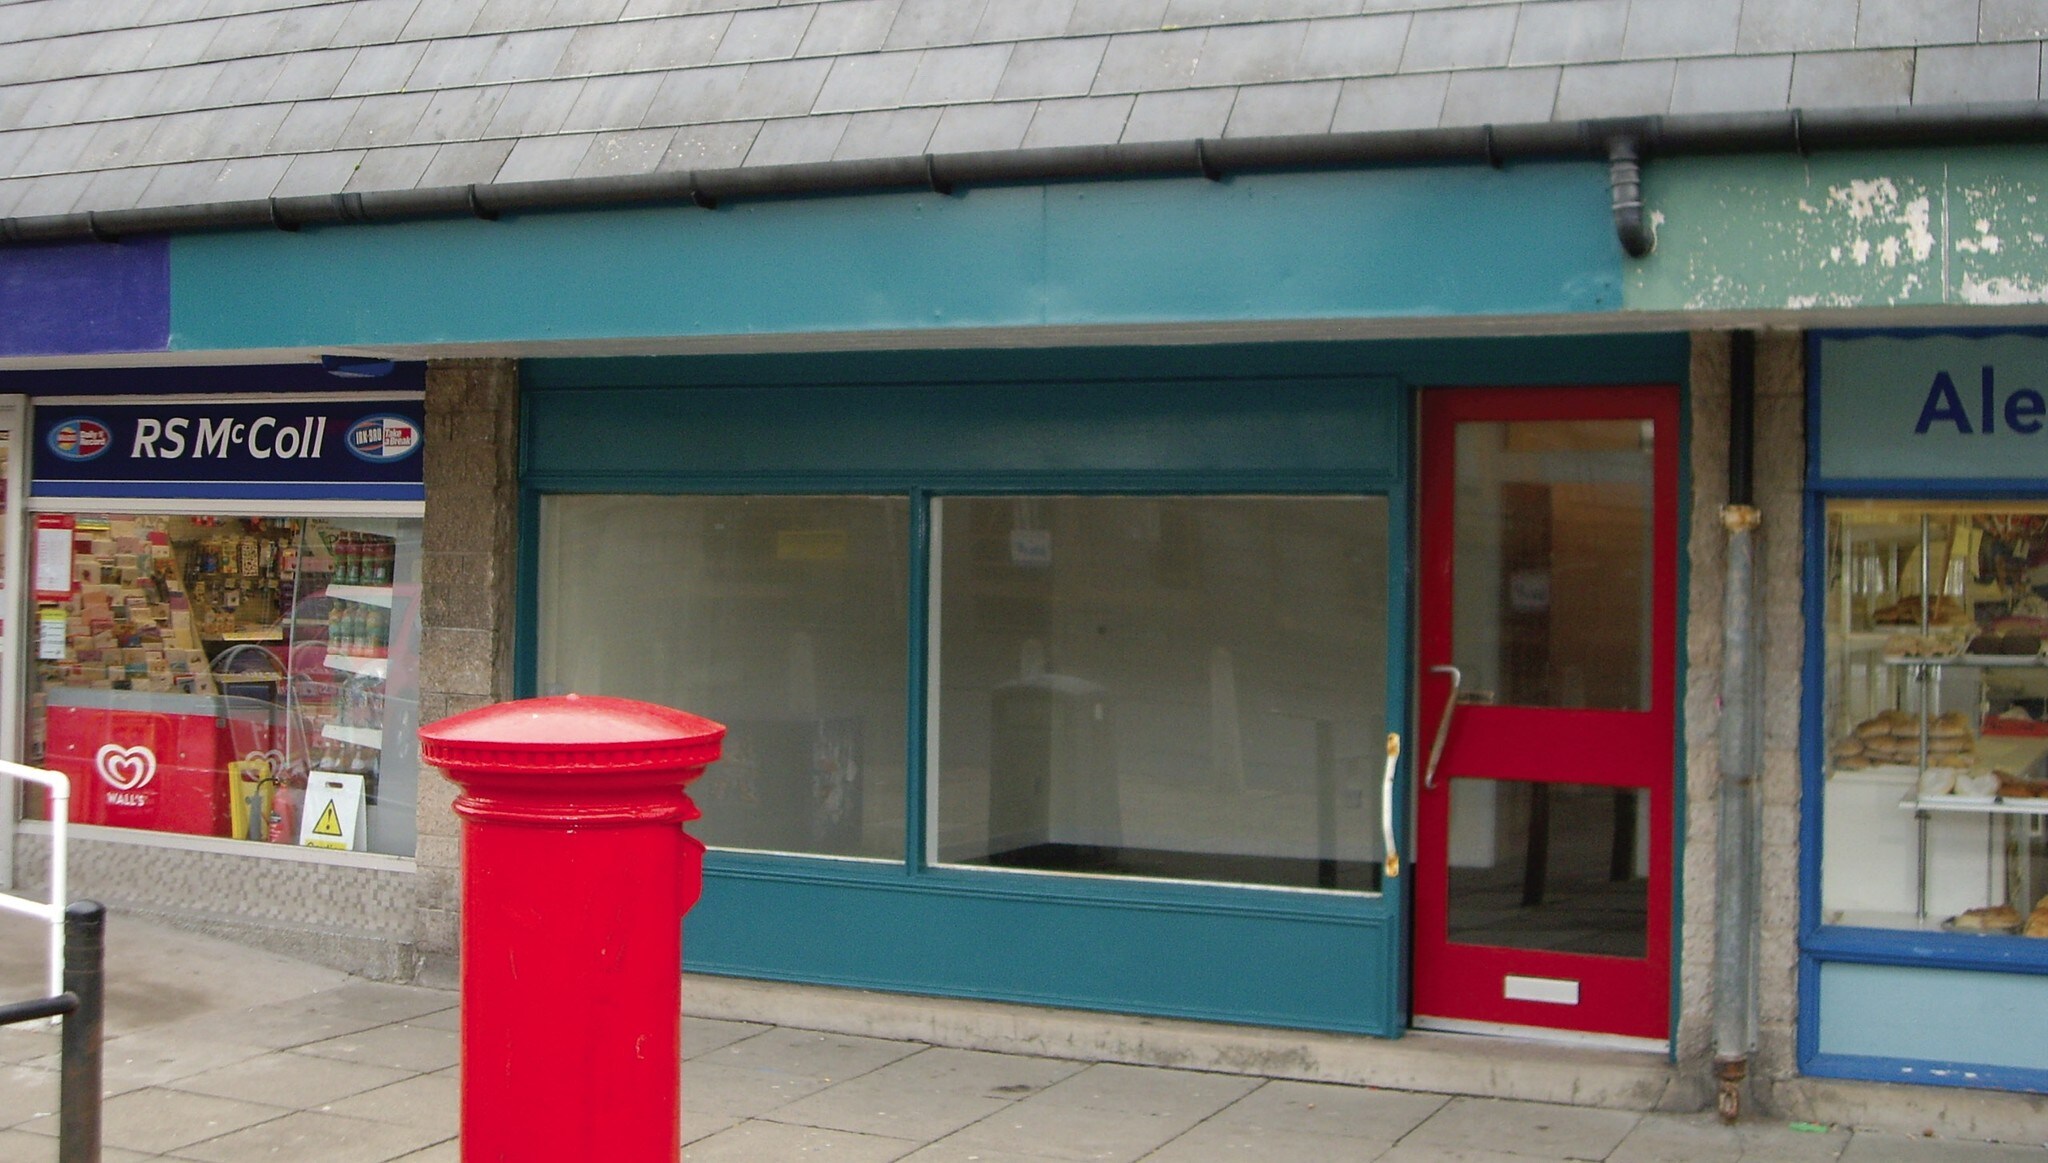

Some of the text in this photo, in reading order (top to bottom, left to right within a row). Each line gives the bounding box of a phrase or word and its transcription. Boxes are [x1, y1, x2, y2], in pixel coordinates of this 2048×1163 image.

[1914, 365, 2047, 435] Ale
[130, 416, 327, 459] RS McColl
